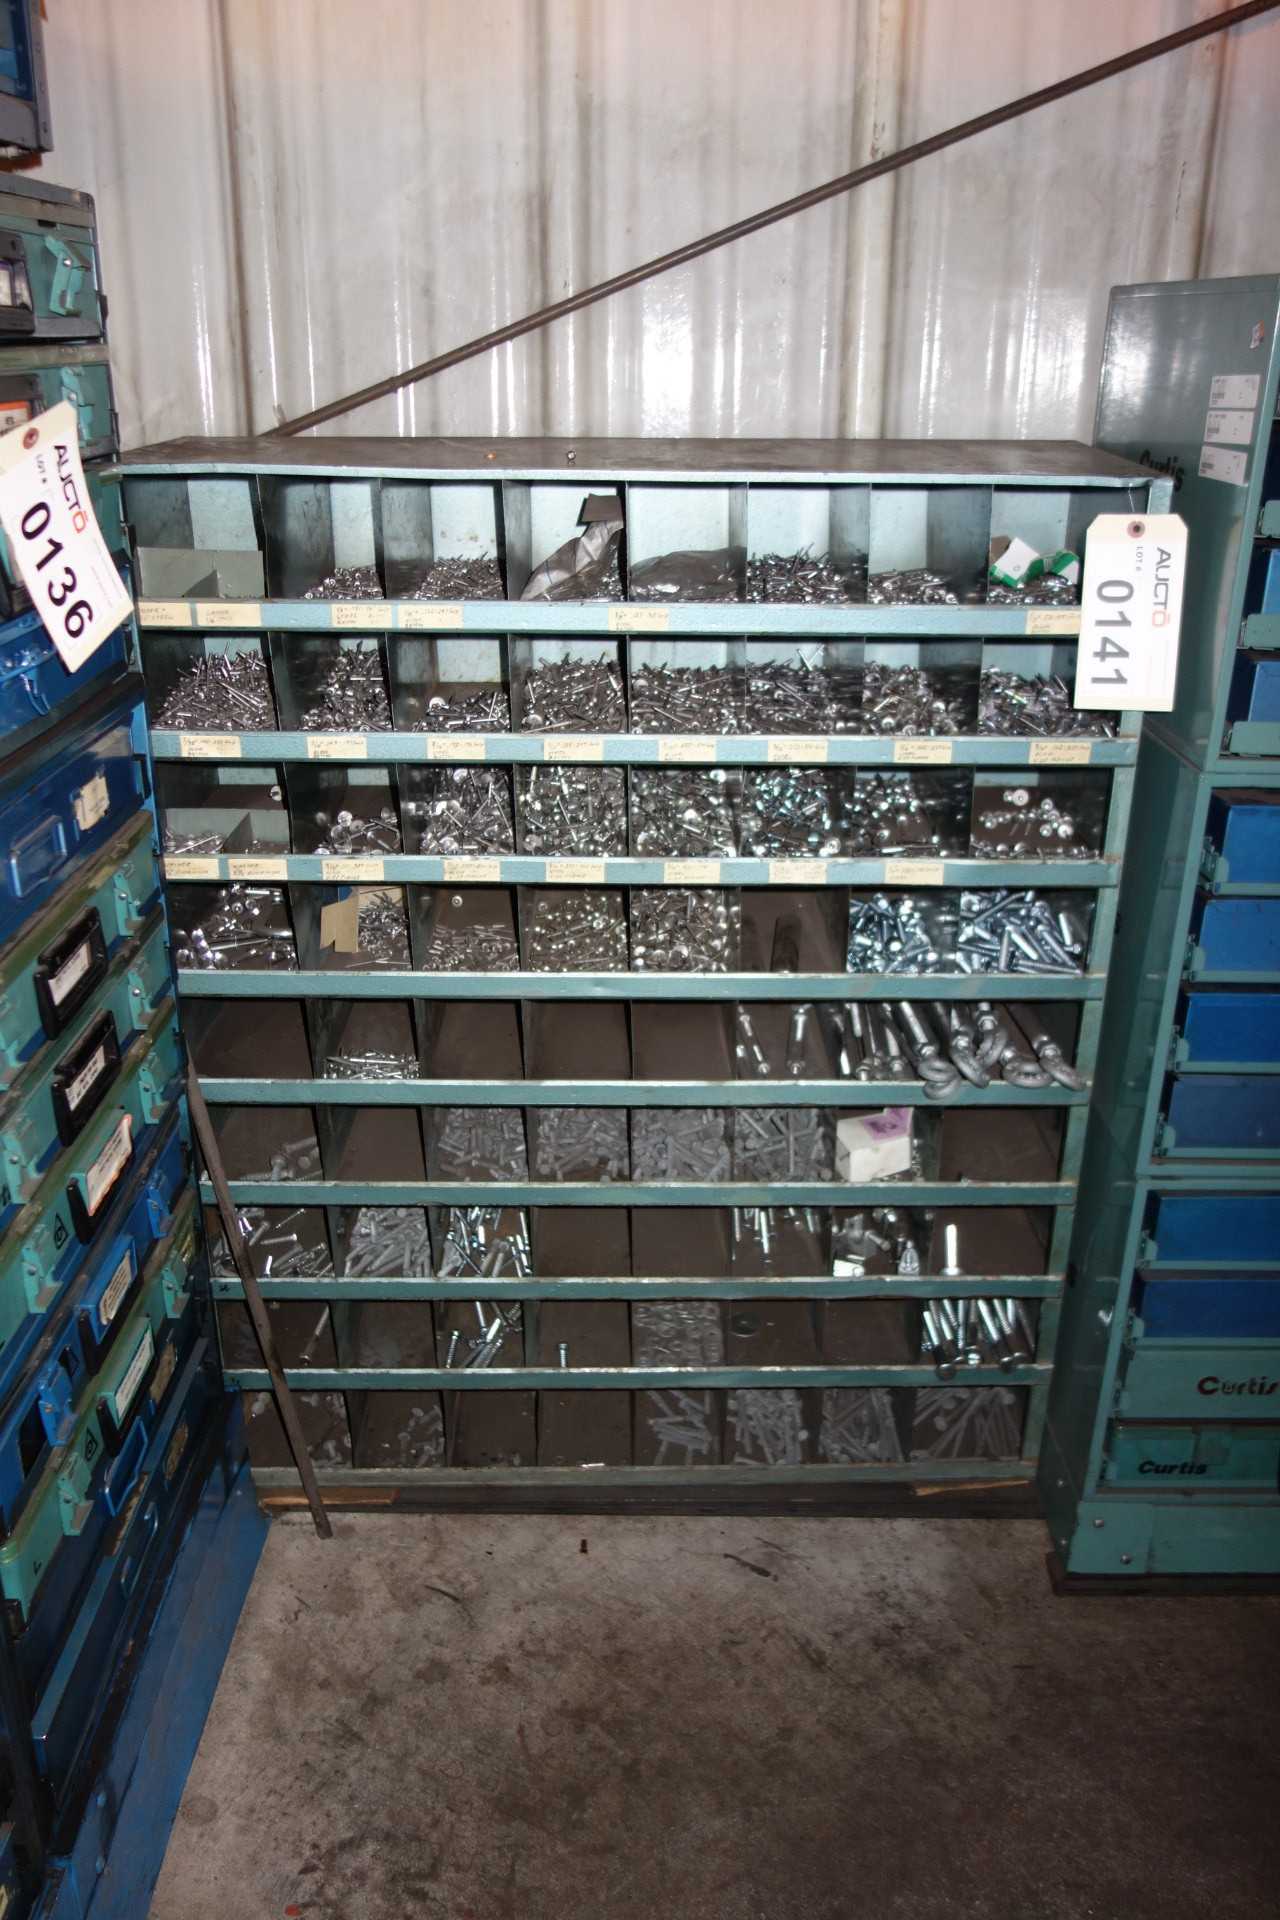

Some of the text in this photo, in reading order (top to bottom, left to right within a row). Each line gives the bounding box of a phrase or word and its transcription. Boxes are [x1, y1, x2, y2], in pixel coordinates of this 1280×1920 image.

[21, 501, 94, 638] 0136
[1091, 579, 1134, 685] 0141
[1197, 1376, 1280, 1395] Curtis
[1138, 1460, 1209, 1475] Curtis
